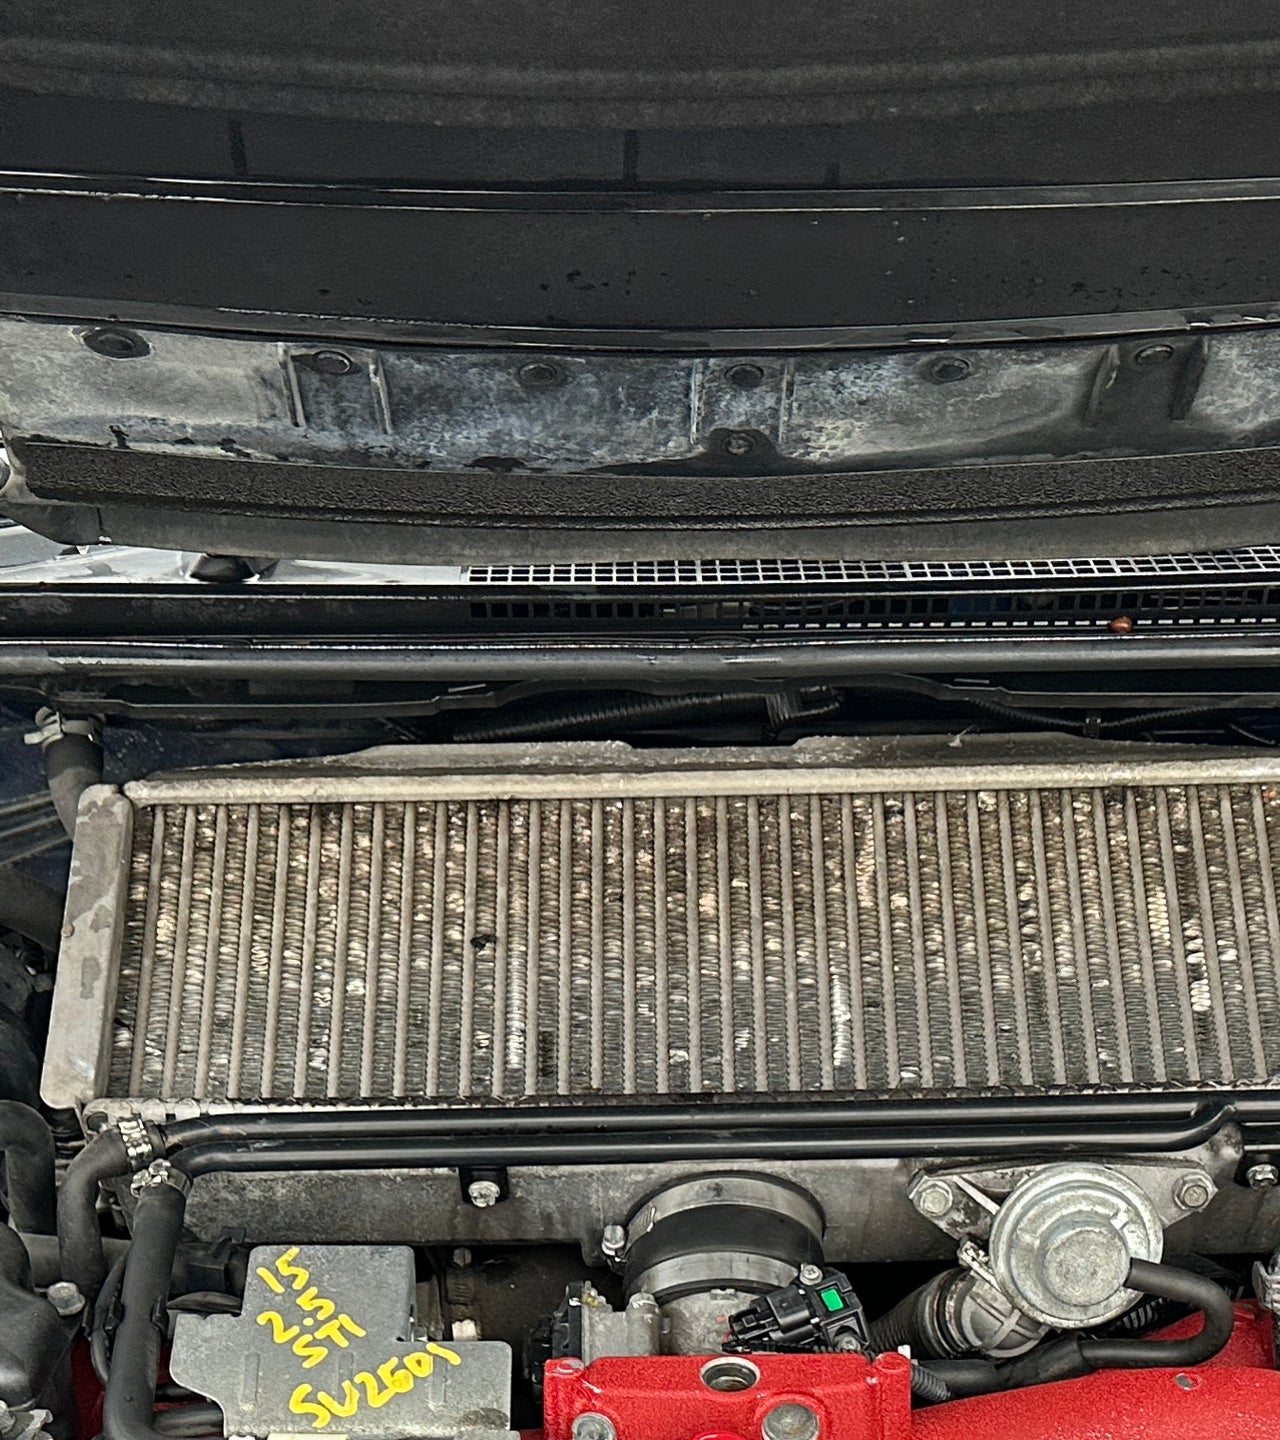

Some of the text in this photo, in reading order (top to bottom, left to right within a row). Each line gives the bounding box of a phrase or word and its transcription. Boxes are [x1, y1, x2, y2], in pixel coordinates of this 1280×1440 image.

[256, 1246, 310, 1294] 15
[256, 1286, 336, 1344] 2.5
[292, 1314, 367, 1369] STI
